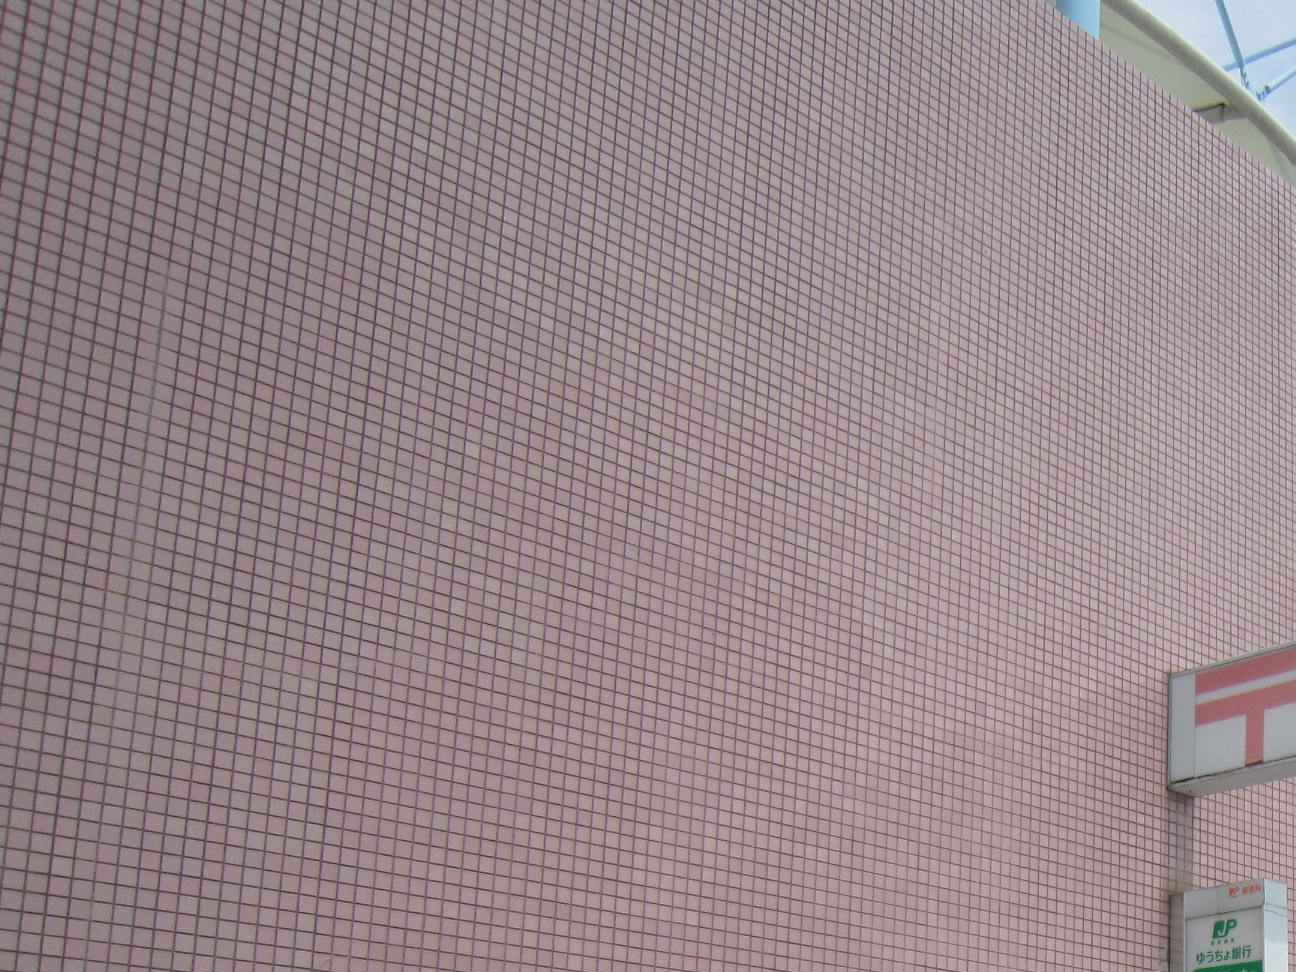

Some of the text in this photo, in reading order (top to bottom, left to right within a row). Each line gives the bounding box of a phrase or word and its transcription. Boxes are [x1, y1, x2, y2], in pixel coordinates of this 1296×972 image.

[1212, 918, 1237, 939] JP
[1196, 945, 1252, 965] ゆうちょ銀行
